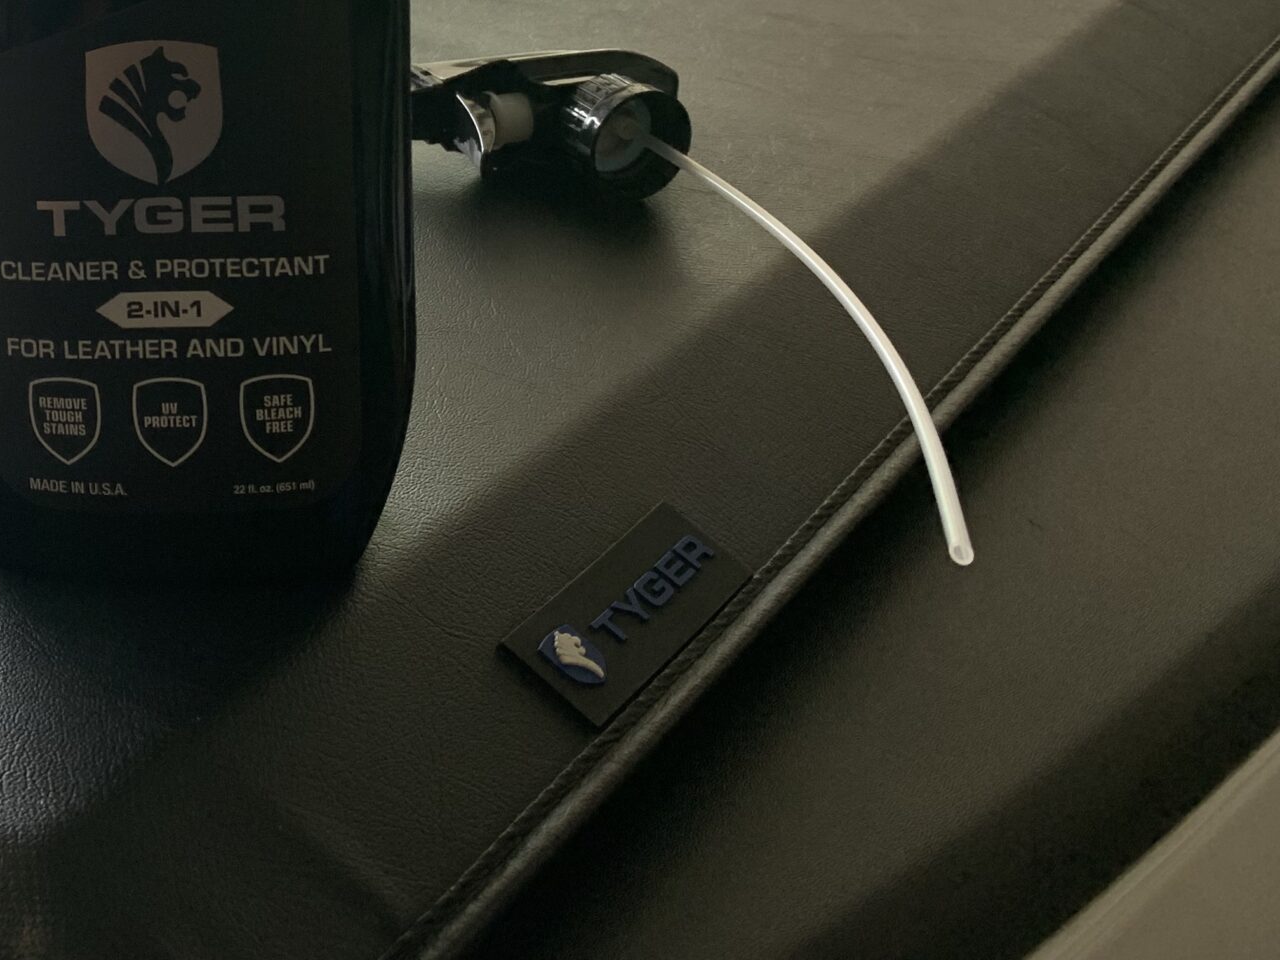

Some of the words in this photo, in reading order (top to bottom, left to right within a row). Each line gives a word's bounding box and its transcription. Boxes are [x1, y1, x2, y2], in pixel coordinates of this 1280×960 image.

[36, 196, 285, 237] TYGER
[1, 261, 118, 281] CLEANER
[128, 260, 147, 280] &
[155, 255, 330, 279] PROTECTANT
[126, 300, 202, 319] 2-IN-1
[7, 338, 55, 359] FOR
[64, 339, 177, 360] LEATHER
[186, 338, 245, 358] AND
[252, 334, 332, 357] VINYL
[39, 397, 87, 410] REMOVE
[263, 394, 293, 408] SAFE
[45, 410, 83, 422] TOUGH
[161, 403, 178, 415] UV
[256, 407, 302, 421] BLEACH
[144, 416, 198, 428] PROTECT
[265, 420, 294, 434] FREE
[43, 423, 86, 436] STAINS
[29, 477, 68, 493] MADE
[71, 481, 85, 494] IN
[89, 482, 128, 496] U.S.A.
[233, 485, 246, 495] 22
[276, 482, 297, 494] (651
[589, 535, 715, 642] TYGER
